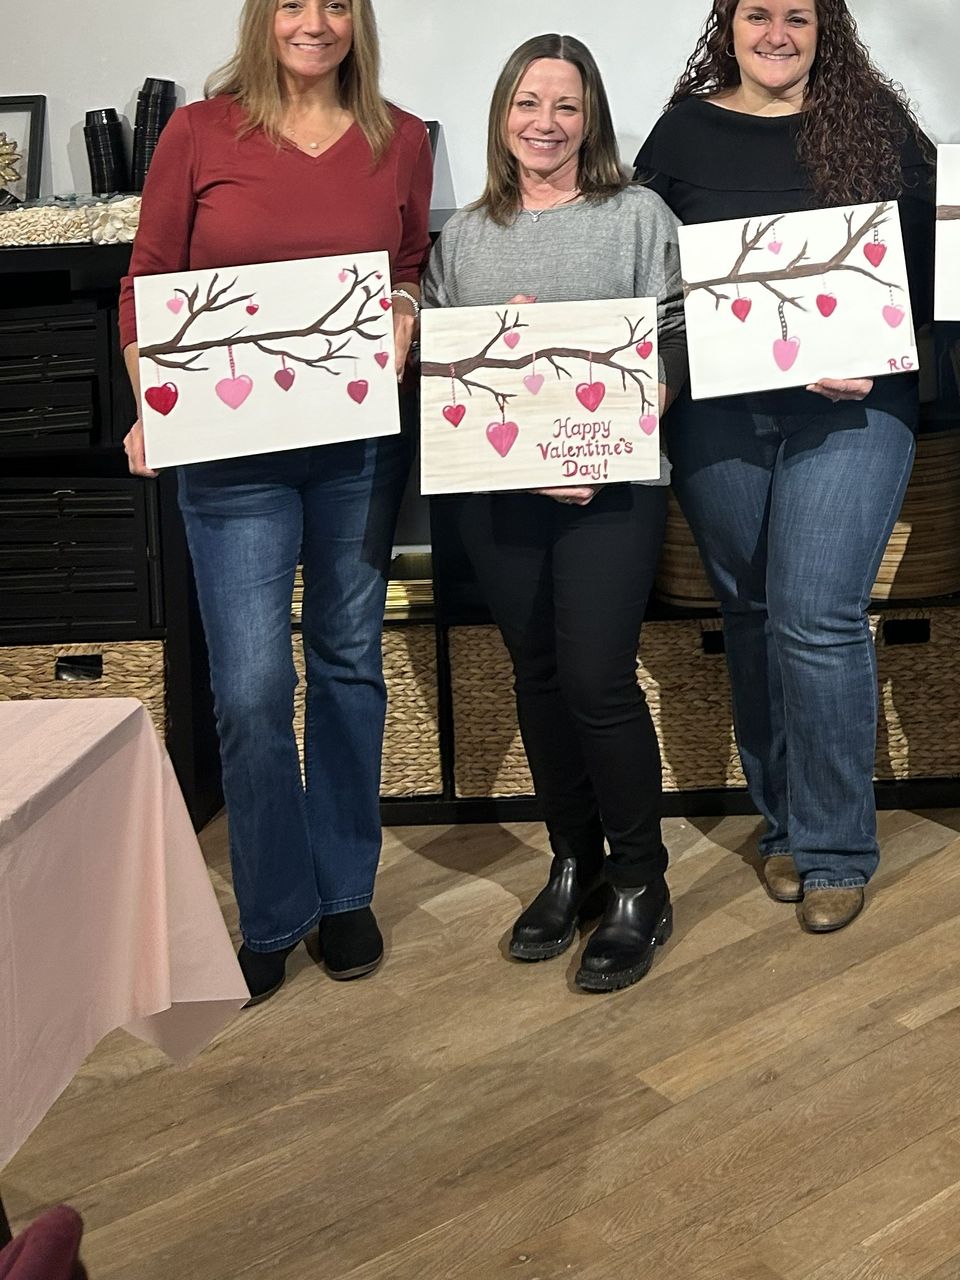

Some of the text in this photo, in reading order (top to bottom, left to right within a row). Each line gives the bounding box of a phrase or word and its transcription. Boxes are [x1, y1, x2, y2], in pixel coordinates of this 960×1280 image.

[887, 356, 914, 371] RG
[553, 417, 611, 440] Happy
[536, 438, 633, 460] Valentine's
[562, 459, 608, 480] Day!
